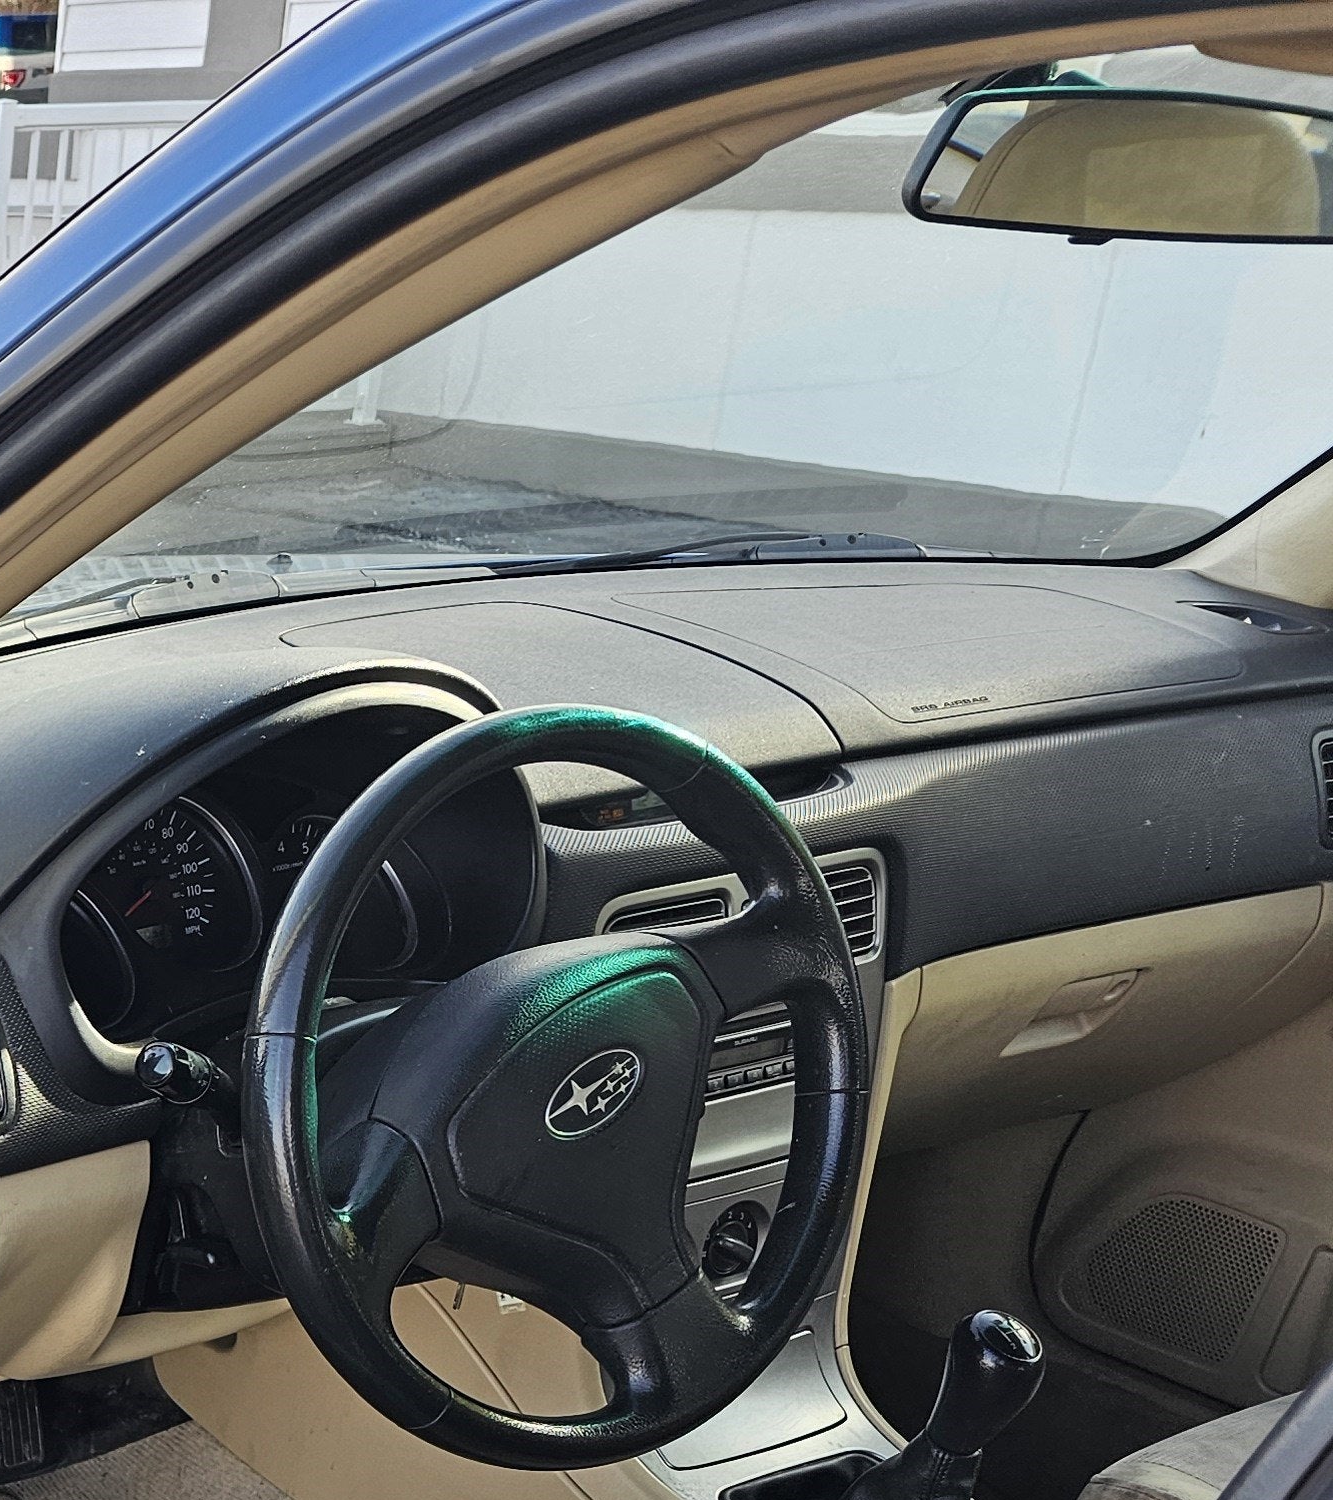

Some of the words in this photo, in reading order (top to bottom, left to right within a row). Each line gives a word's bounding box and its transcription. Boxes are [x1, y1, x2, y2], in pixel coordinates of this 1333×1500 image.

[943, 695, 991, 709] AIRBAG
[161, 826, 174, 839] 80
[176, 842, 189, 855] 90
[277, 841, 285, 853] 4
[302, 841, 310, 854] 5
[182, 861, 198, 875] 100
[186, 884, 201, 897] 110
[185, 907, 201, 920] 120
[184, 925, 201, 935] MPH
